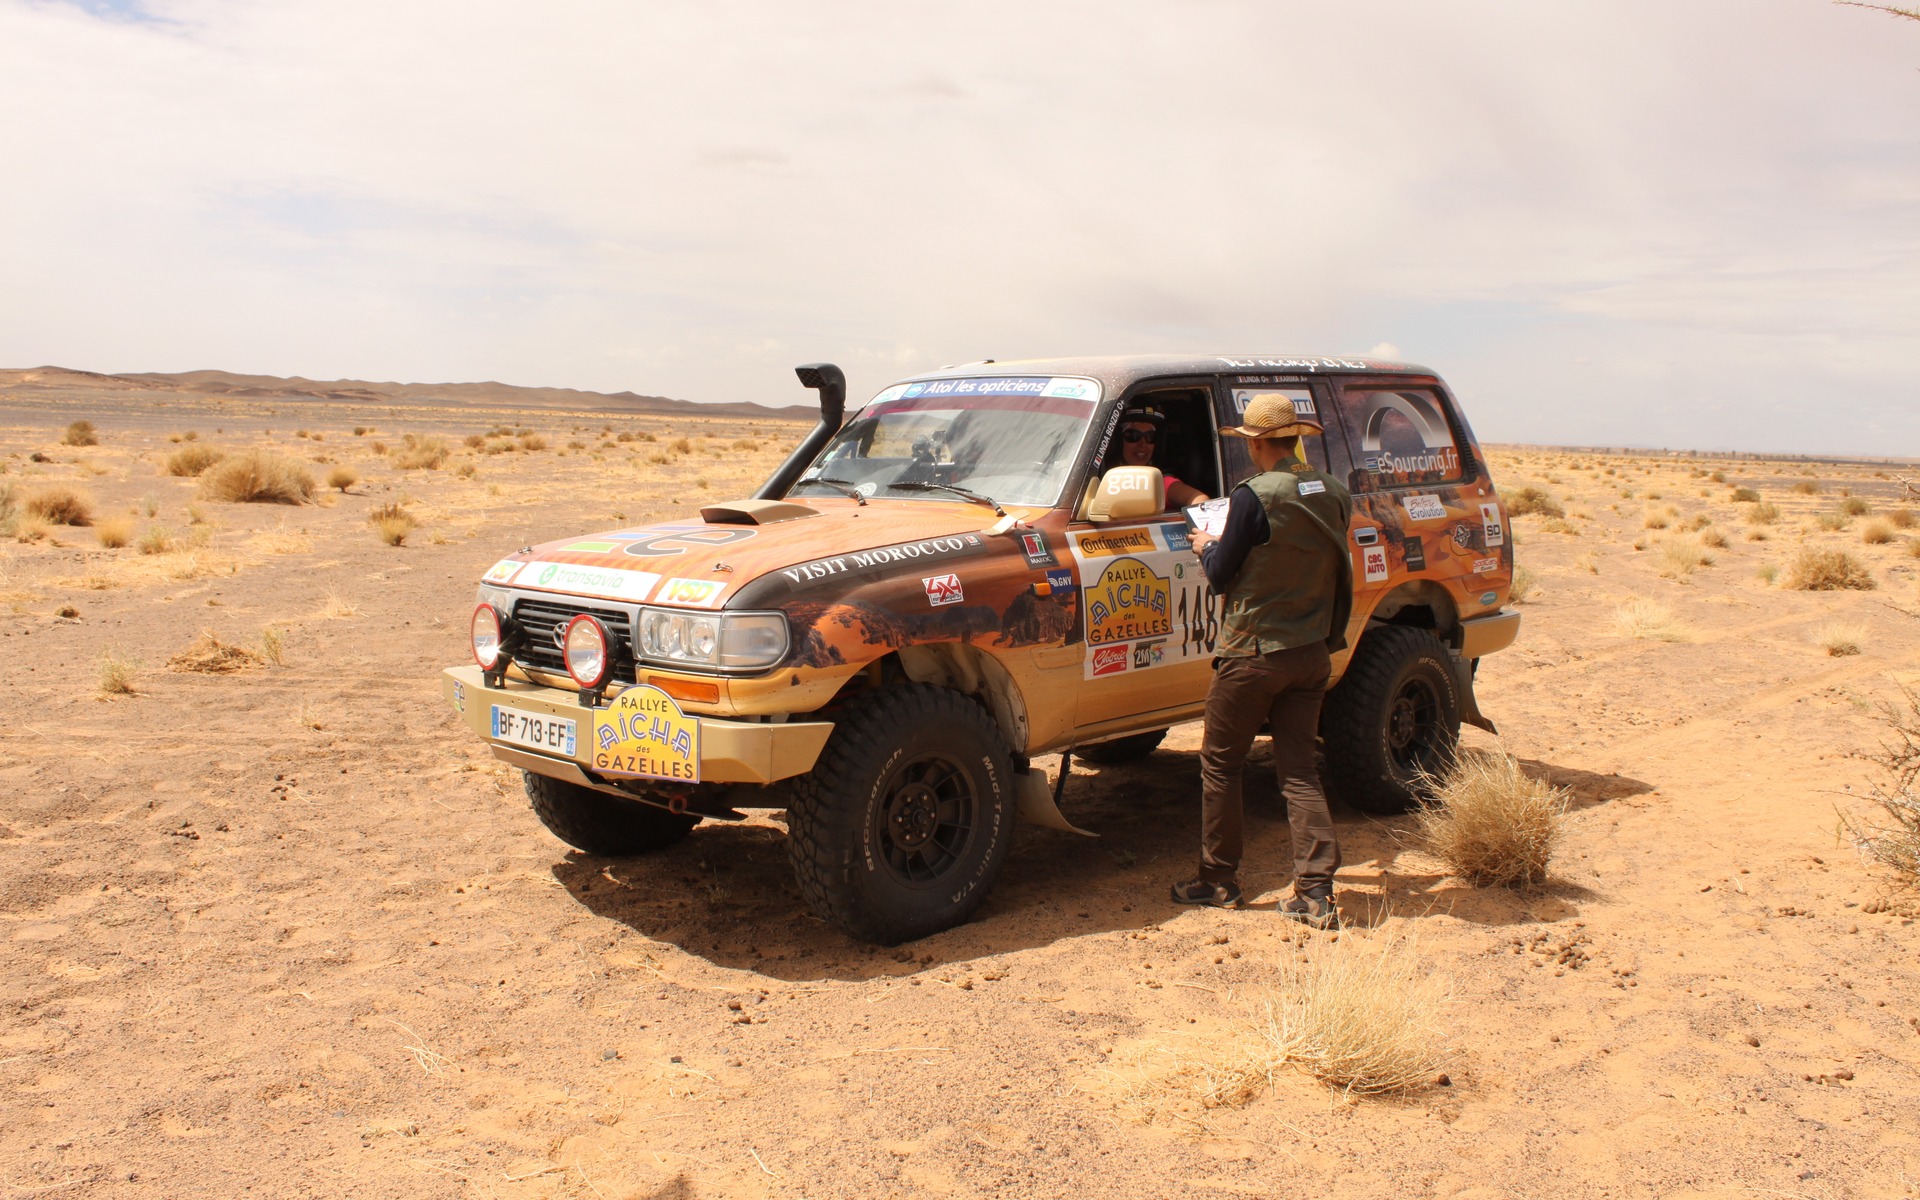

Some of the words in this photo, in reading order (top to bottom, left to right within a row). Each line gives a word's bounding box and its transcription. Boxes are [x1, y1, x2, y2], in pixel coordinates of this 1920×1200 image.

[924, 380, 955, 395] Atol
[955, 380, 975, 393] les
[977, 378, 1045, 394] opticiens
[1096, 436, 1111, 460] LINDA
[1105, 409, 1120, 437] BENZID
[1377, 448, 1458, 476] eSourcing.fr
[1107, 472, 1149, 495] gan
[1409, 506, 1446, 519] Evolution
[1486, 524, 1501, 536] SD
[1081, 533, 1142, 554] Continental
[783, 557, 849, 584] VISIT
[850, 538, 963, 568] MOROCCO
[1030, 556, 1053, 565] MAROC
[1367, 554, 1383, 564] CBC
[1107, 567, 1146, 583] RALLYE
[1367, 563, 1386, 575] AUTO
[556, 567, 625, 589] transavia
[1058, 575, 1072, 587] GNV
[667, 580, 716, 603] VSD
[1123, 612, 1136, 621] des
[1178, 585, 1218, 657] 148
[1090, 618, 1169, 643] GAZELLES
[1134, 648, 1150, 665] 2M
[621, 696, 668, 713] RALLYE
[636, 745, 651, 754] des
[596, 752, 694, 779] GAZELLES
